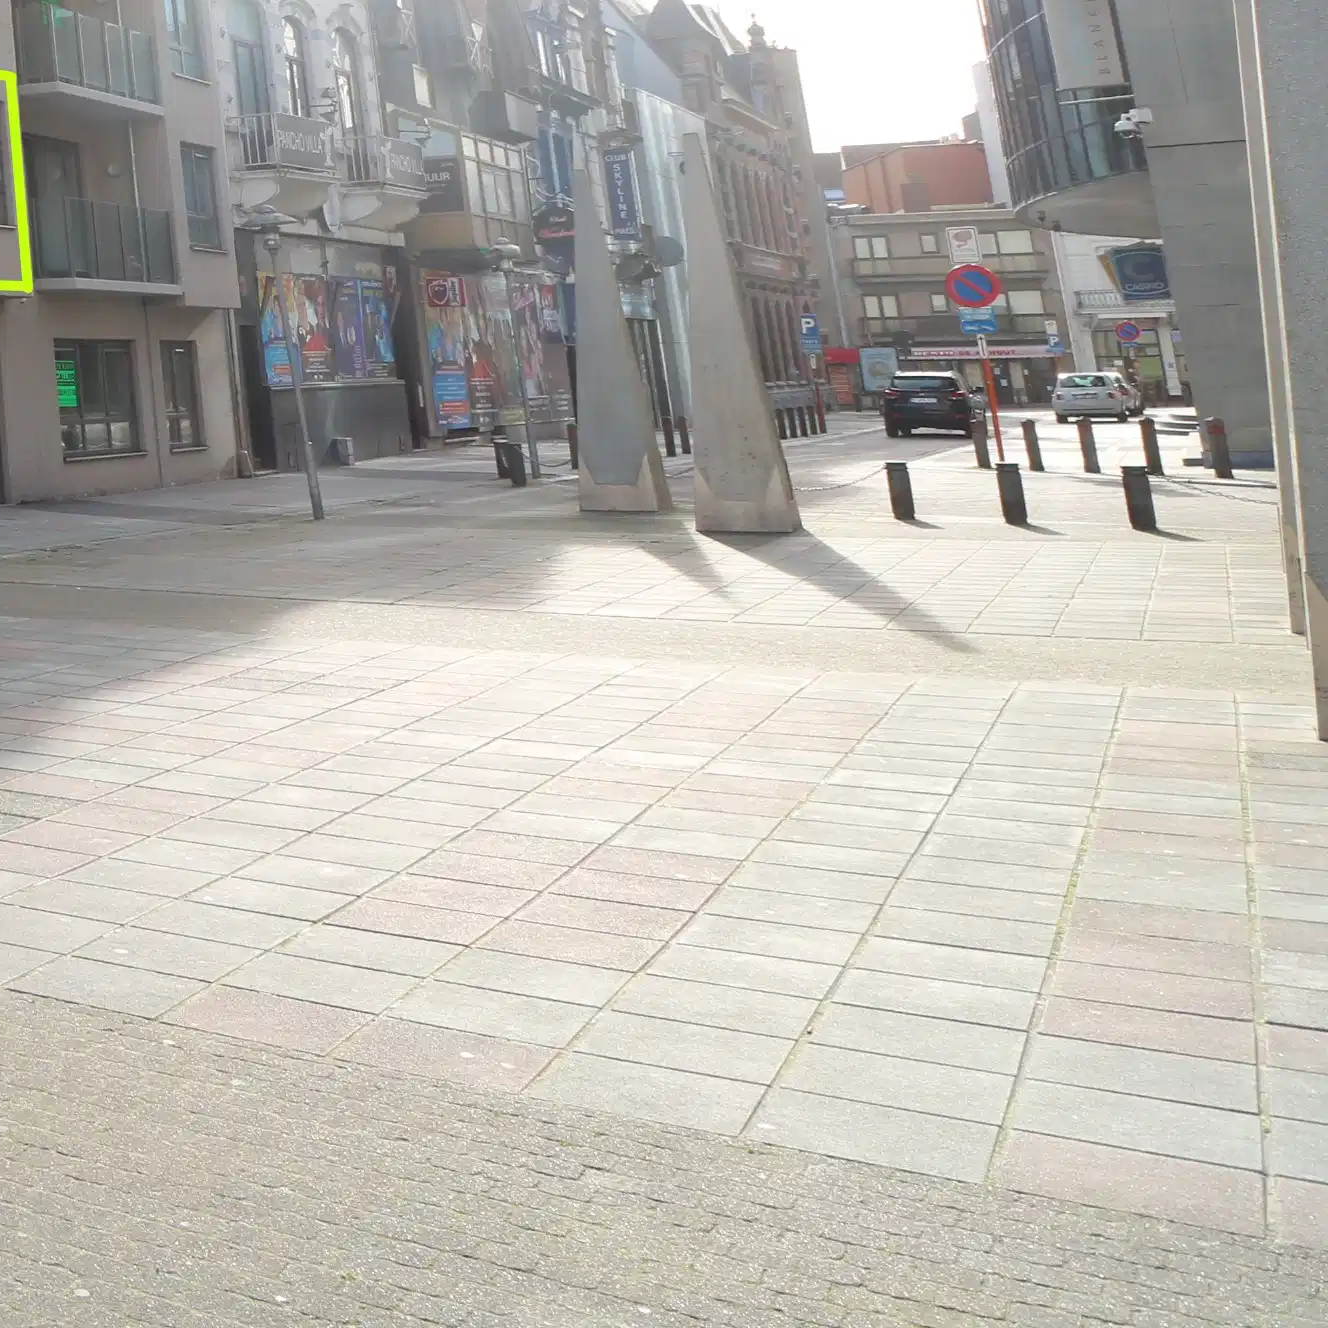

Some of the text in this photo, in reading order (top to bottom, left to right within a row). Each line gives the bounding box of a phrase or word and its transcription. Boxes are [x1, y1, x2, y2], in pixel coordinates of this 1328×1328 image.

[279, 129, 323, 154] PANCHO VILLA
[612, 163, 629, 219] SKYLINE
[800, 317, 815, 334] P
[1049, 336, 1059, 346] P
